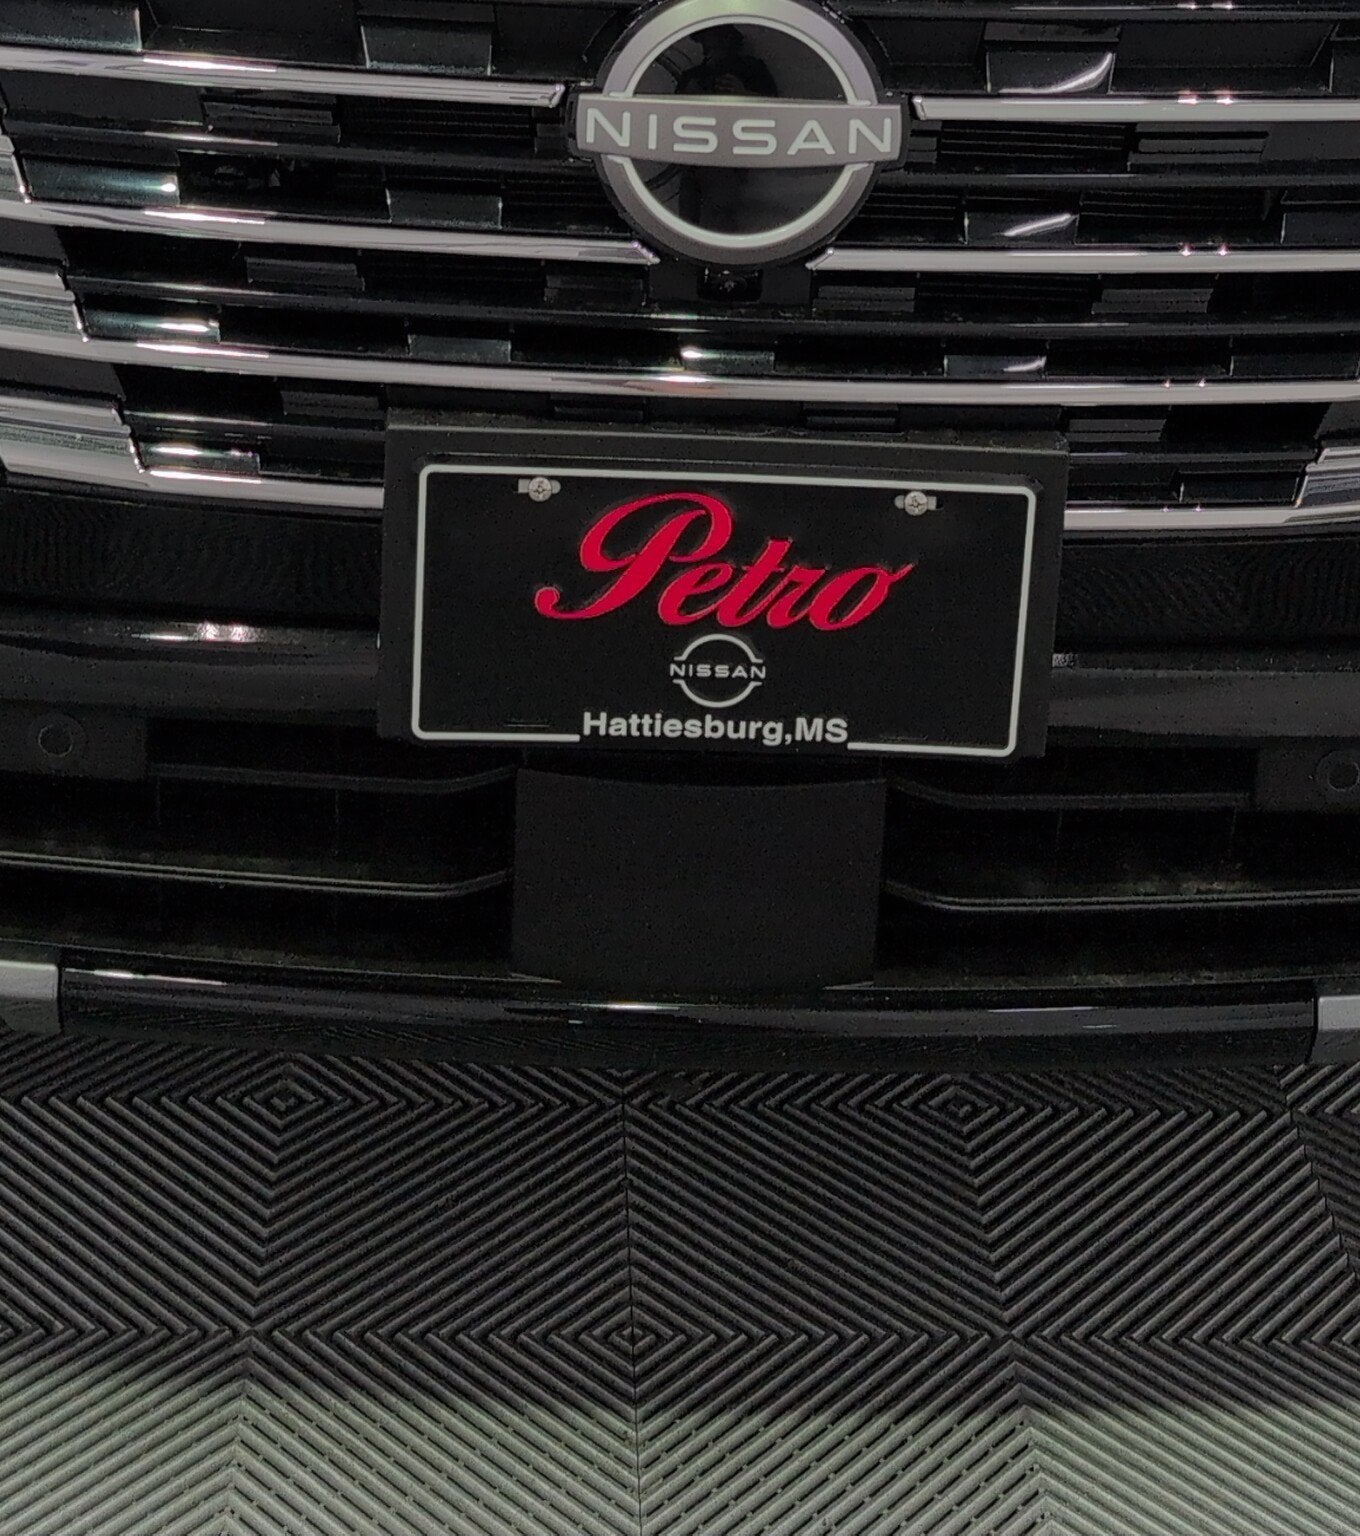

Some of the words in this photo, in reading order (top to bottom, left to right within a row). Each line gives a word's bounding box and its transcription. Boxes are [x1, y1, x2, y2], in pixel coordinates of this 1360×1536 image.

[585, 107, 892, 155] NISSAN
[532, 490, 915, 632] Petro
[669, 663, 766, 680] NISSAN
